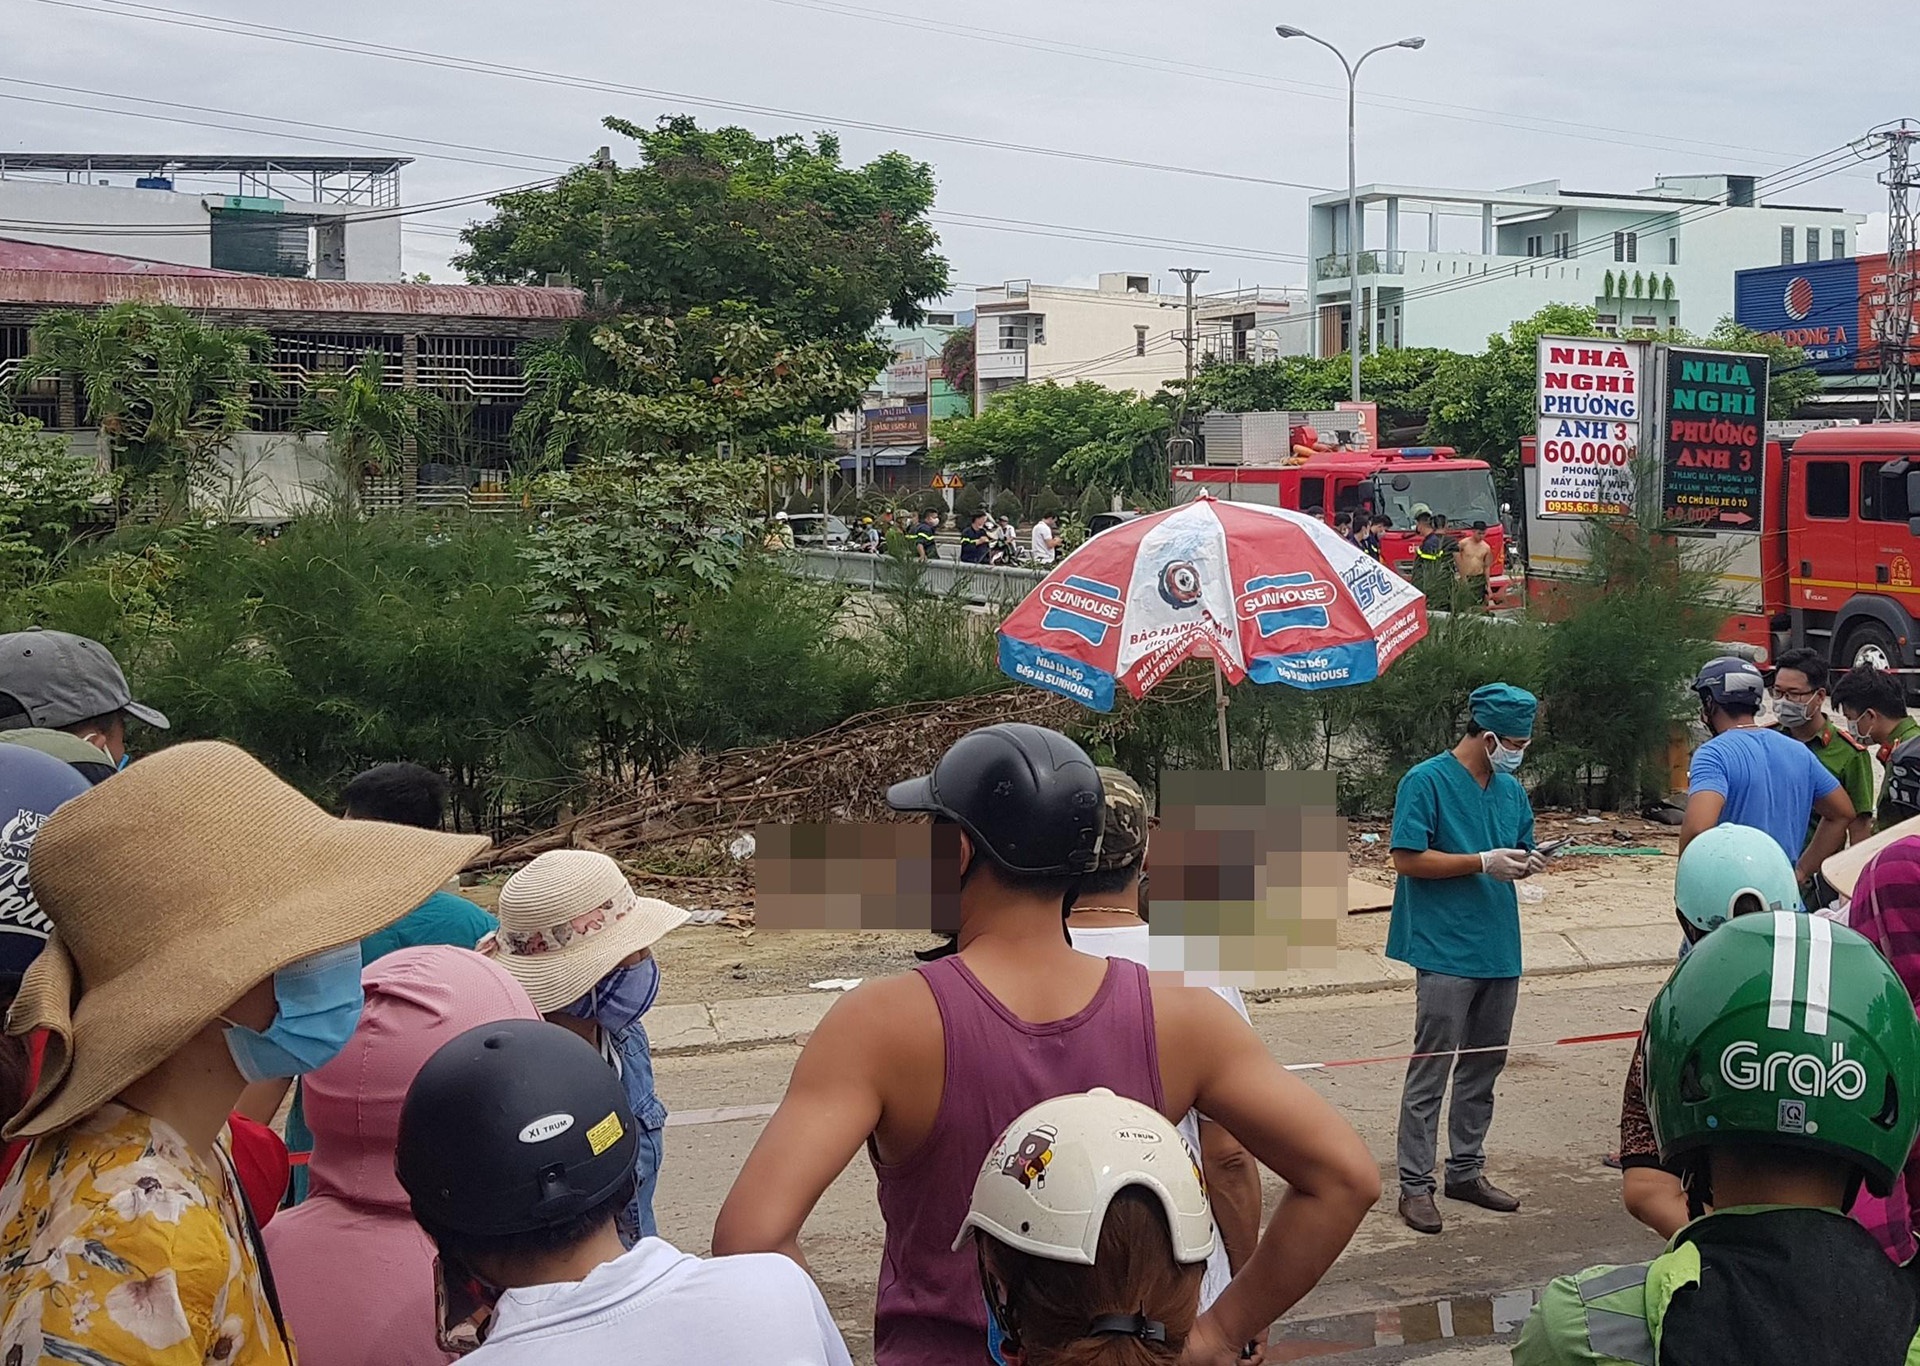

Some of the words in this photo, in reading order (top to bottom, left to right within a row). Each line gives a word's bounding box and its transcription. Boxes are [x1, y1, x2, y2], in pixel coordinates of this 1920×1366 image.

[1550, 346, 1629, 368] NHÀ
[1545, 370, 1635, 393] NGHỈ
[1682, 358, 1751, 386] NHÀ
[1544, 393, 1635, 417] PHƯƠNG
[1673, 386, 1756, 415] NGHỈ
[1555, 420, 1608, 439] ANH
[1614, 422, 1627, 441] 3
[1671, 418, 1758, 446] PHƯƠNG
[1677, 447, 1731, 469] ANH
[1739, 450, 1752, 471] 3
[1550, 475, 1571, 485] MÁY
[1545, 488, 1558, 498] CÓ
[1050, 589, 1120, 619] SUNHOUSE
[1243, 587, 1326, 612] SUNHOUSE
[1035, 655, 1055, 670] Nhà
[1056, 662, 1065, 674] là
[1065, 665, 1084, 681] bếp
[1307, 655, 1328, 668] bếp
[1016, 663, 1035, 678] Bếp
[1035, 670, 1045, 681] là
[1044, 673, 1094, 700] SUNHOUSE
[1719, 1040, 1867, 1101] Grab
[528, 1127, 540, 1139] XI
[543, 1120, 568, 1134] TRUM
[1132, 1132, 1154, 1140] TRUM
